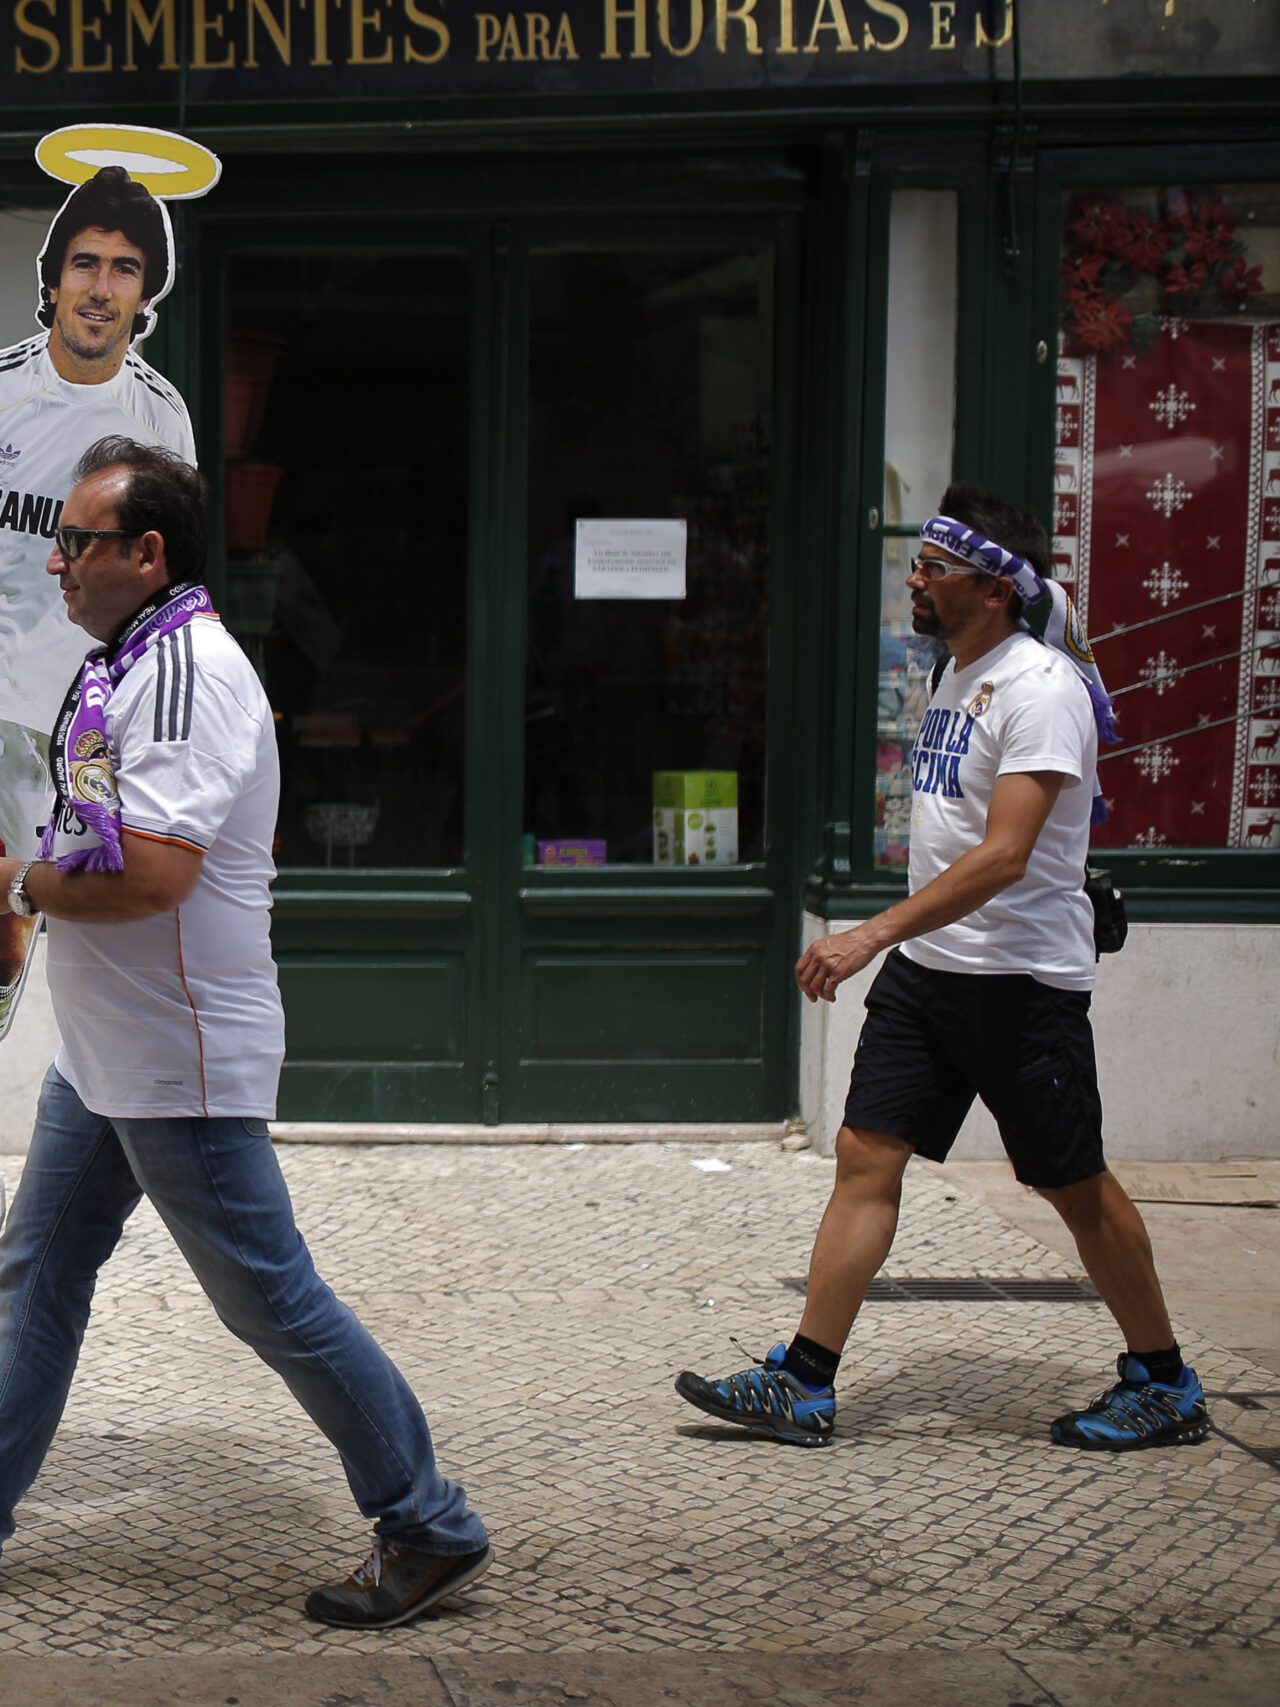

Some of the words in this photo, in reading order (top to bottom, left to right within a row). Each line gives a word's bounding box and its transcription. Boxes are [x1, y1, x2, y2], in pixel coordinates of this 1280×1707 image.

[13, 0, 451, 74] SEMENTES
[475, 12, 579, 63] PARA
[600, 0, 911, 59] HORTAS
[929, 1, 956, 51] E
[140, 604, 157, 622] REAL
[915, 707, 952, 751] POR
[946, 711, 975, 756] LA
[56, 756, 65, 781] MADRID
